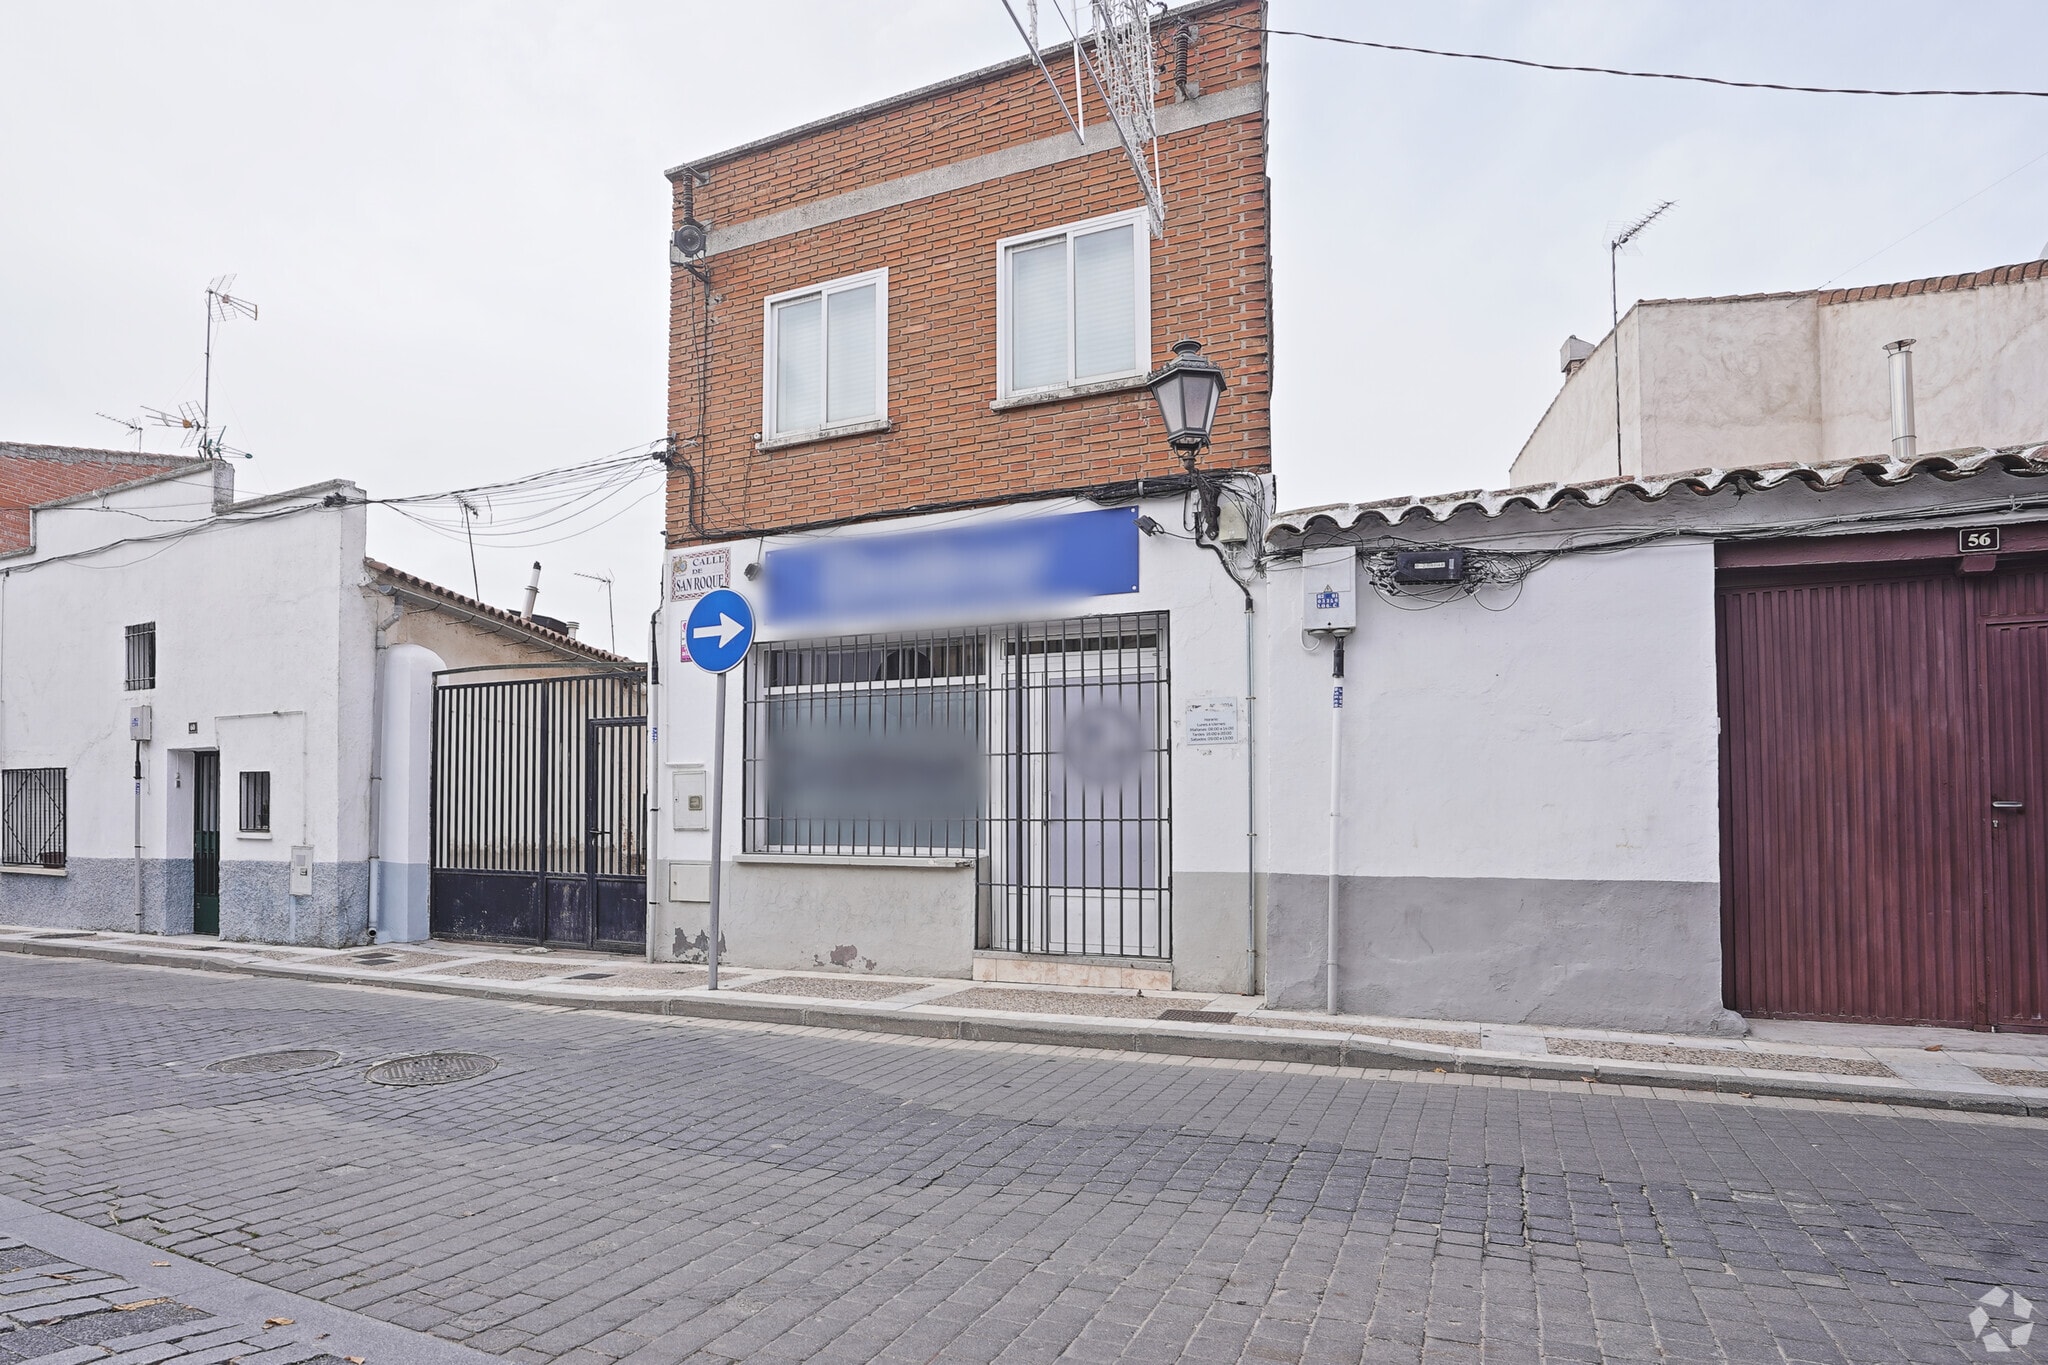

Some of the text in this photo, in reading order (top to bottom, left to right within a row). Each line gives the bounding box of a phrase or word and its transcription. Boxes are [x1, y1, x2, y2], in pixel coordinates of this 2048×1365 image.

[1968, 532, 1991, 547] 56
[692, 555, 724, 567] CALLE
[676, 573, 724, 592] SAN ROQUE
